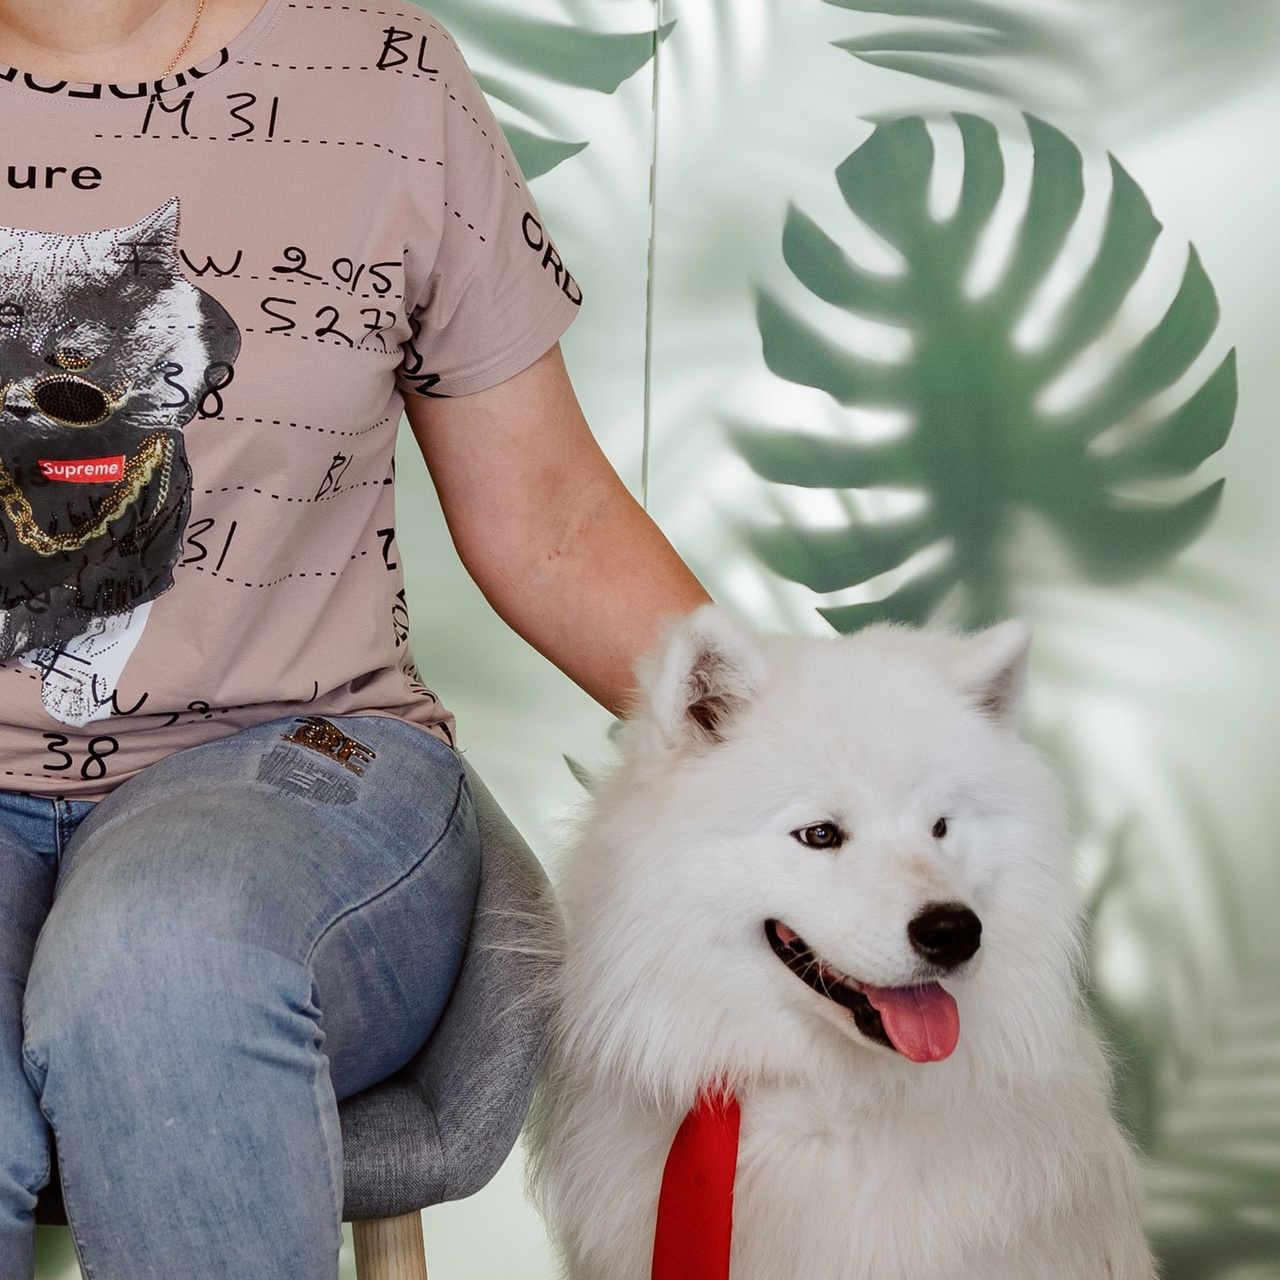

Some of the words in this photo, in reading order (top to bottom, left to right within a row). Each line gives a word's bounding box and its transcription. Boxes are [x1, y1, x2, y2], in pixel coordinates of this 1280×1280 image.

[226, 92, 279, 138] 31
[161, 362, 235, 418] 38
[42, 462, 119, 478] Supreme
[182, 518, 237, 571] 31
[42, 733, 119, 780] 38
